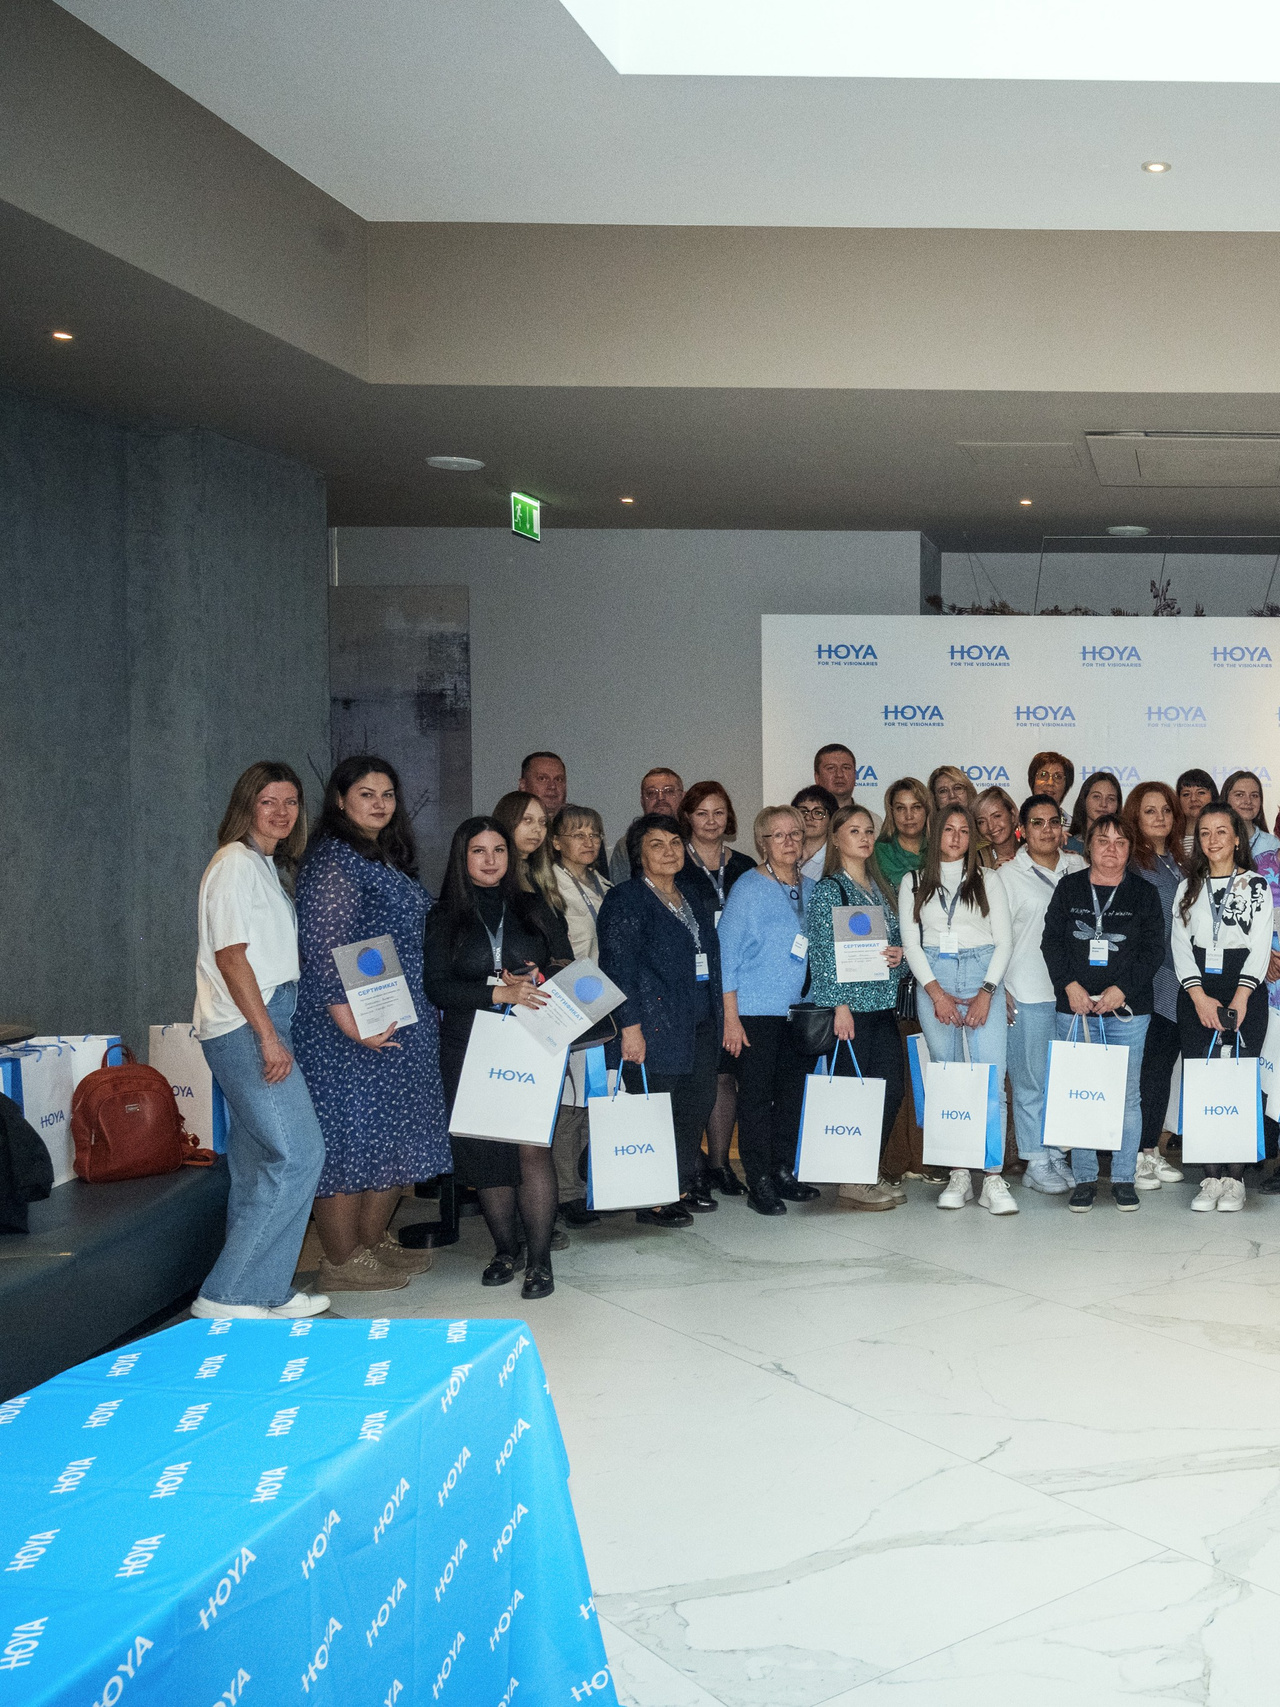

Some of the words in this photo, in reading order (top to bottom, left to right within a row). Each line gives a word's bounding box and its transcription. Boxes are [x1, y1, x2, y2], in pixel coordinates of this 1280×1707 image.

[814, 644, 878, 659] HOYA
[946, 645, 1011, 660] HOYA
[1078, 645, 1142, 660] HOYA
[1210, 647, 1273, 662] HOYA
[880, 705, 945, 720] HOYA
[1013, 706, 1076, 721] HOYA
[1145, 706, 1207, 721] HOYA
[855, 765, 878, 780] YA
[358, 981, 398, 996] СЕРТИФИКАТ
[551, 988, 584, 1021] СЕРТИФИКАТ
[488, 1066, 536, 1085] HOYA
[1259, 1056, 1274, 1072] OYA
[172, 1085, 194, 1098] OYA
[1068, 1089, 1106, 1102] HOYA
[40, 1110, 65, 1129] HOYA
[940, 1109, 972, 1121] HOYA
[1203, 1104, 1239, 1117] HOYA
[823, 1124, 862, 1137] HOYA
[613, 1142, 655, 1157] HOYA
[207, 1318, 233, 1336] HOY
[289, 1319, 314, 1337] HOY
[446, 1320, 468, 1343] HOYA
[107, 1352, 142, 1378] HOYA
[195, 1354, 228, 1380] HOYA
[280, 1357, 310, 1383] HOYA
[364, 1360, 392, 1387] HOYA
[499, 1336, 530, 1388] HOYA
[441, 1363, 473, 1413] HOYA
[0, 1396, 31, 1425] HOYA
[83, 1399, 124, 1429] HOYA
[174, 1403, 212, 1433] HOYA
[266, 1406, 300, 1437] HOYA
[358, 1410, 389, 1442] HOYA
[496, 1418, 531, 1475] HOYA
[50, 1456, 97, 1495] HOYA
[150, 1461, 192, 1499] HOYA
[250, 1466, 288, 1503] HOYA
[438, 1446, 472, 1508] HOYA
[374, 1477, 411, 1544] HOYA
[301, 1510, 341, 1580] HOYA
[492, 1503, 529, 1563] HOYA
[5, 1529, 60, 1572] HOYA
[115, 1534, 166, 1578] HOYA
[434, 1538, 468, 1603] HOYA
[198, 1546, 257, 1632] HOYA
[366, 1577, 408, 1648] HOYA
[489, 1589, 525, 1652] HOYA
[0, 1617, 49, 1671] HOYA
[301, 1616, 343, 1693] HOYA
[432, 1631, 466, 1700] HOYA
[213, 1668, 251, 1707] YA
[383, 1679, 404, 1707] YA
[497, 1677, 519, 1707] YA
[570, 1664, 609, 1702] HO
